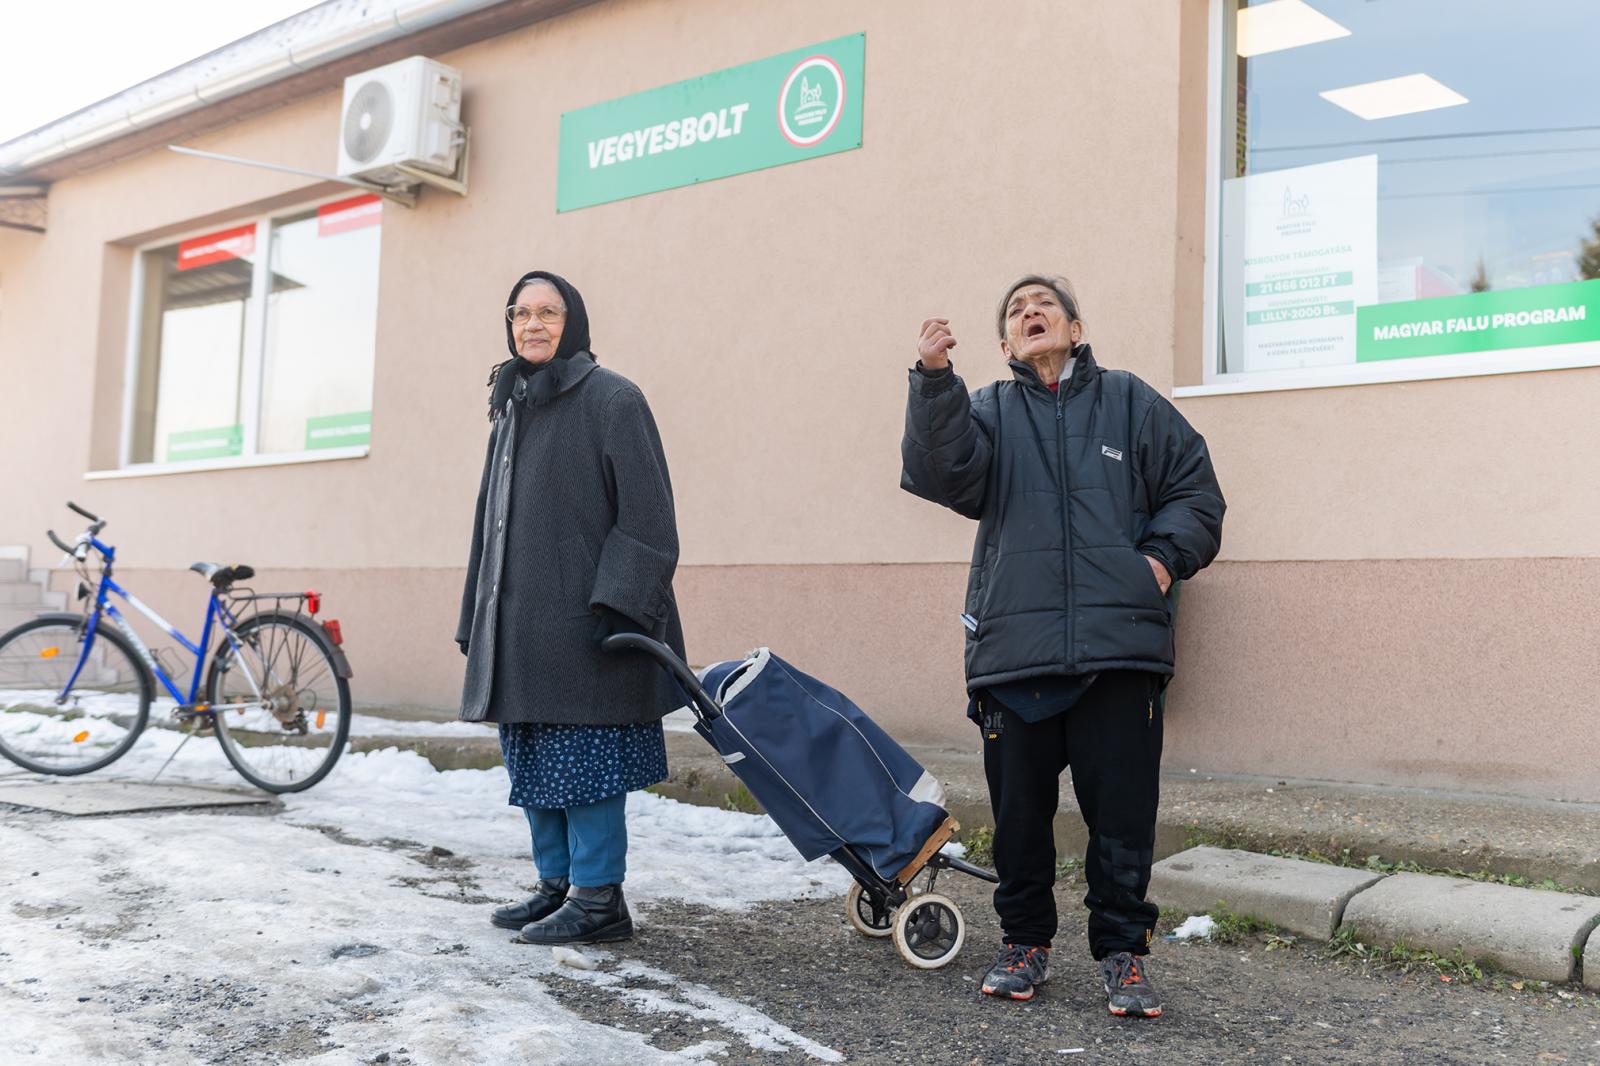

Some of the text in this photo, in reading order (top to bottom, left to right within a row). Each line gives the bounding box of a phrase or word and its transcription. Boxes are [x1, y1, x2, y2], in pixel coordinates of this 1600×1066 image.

[588, 102, 750, 169] VEGYESBOLT
[1299, 276, 1321, 289] 012
[1323, 274, 1338, 286] FT
[1261, 305, 1322, 322] LILLY-2000
[1373, 305, 1586, 341] MAGYAR FALU PROGRAM
